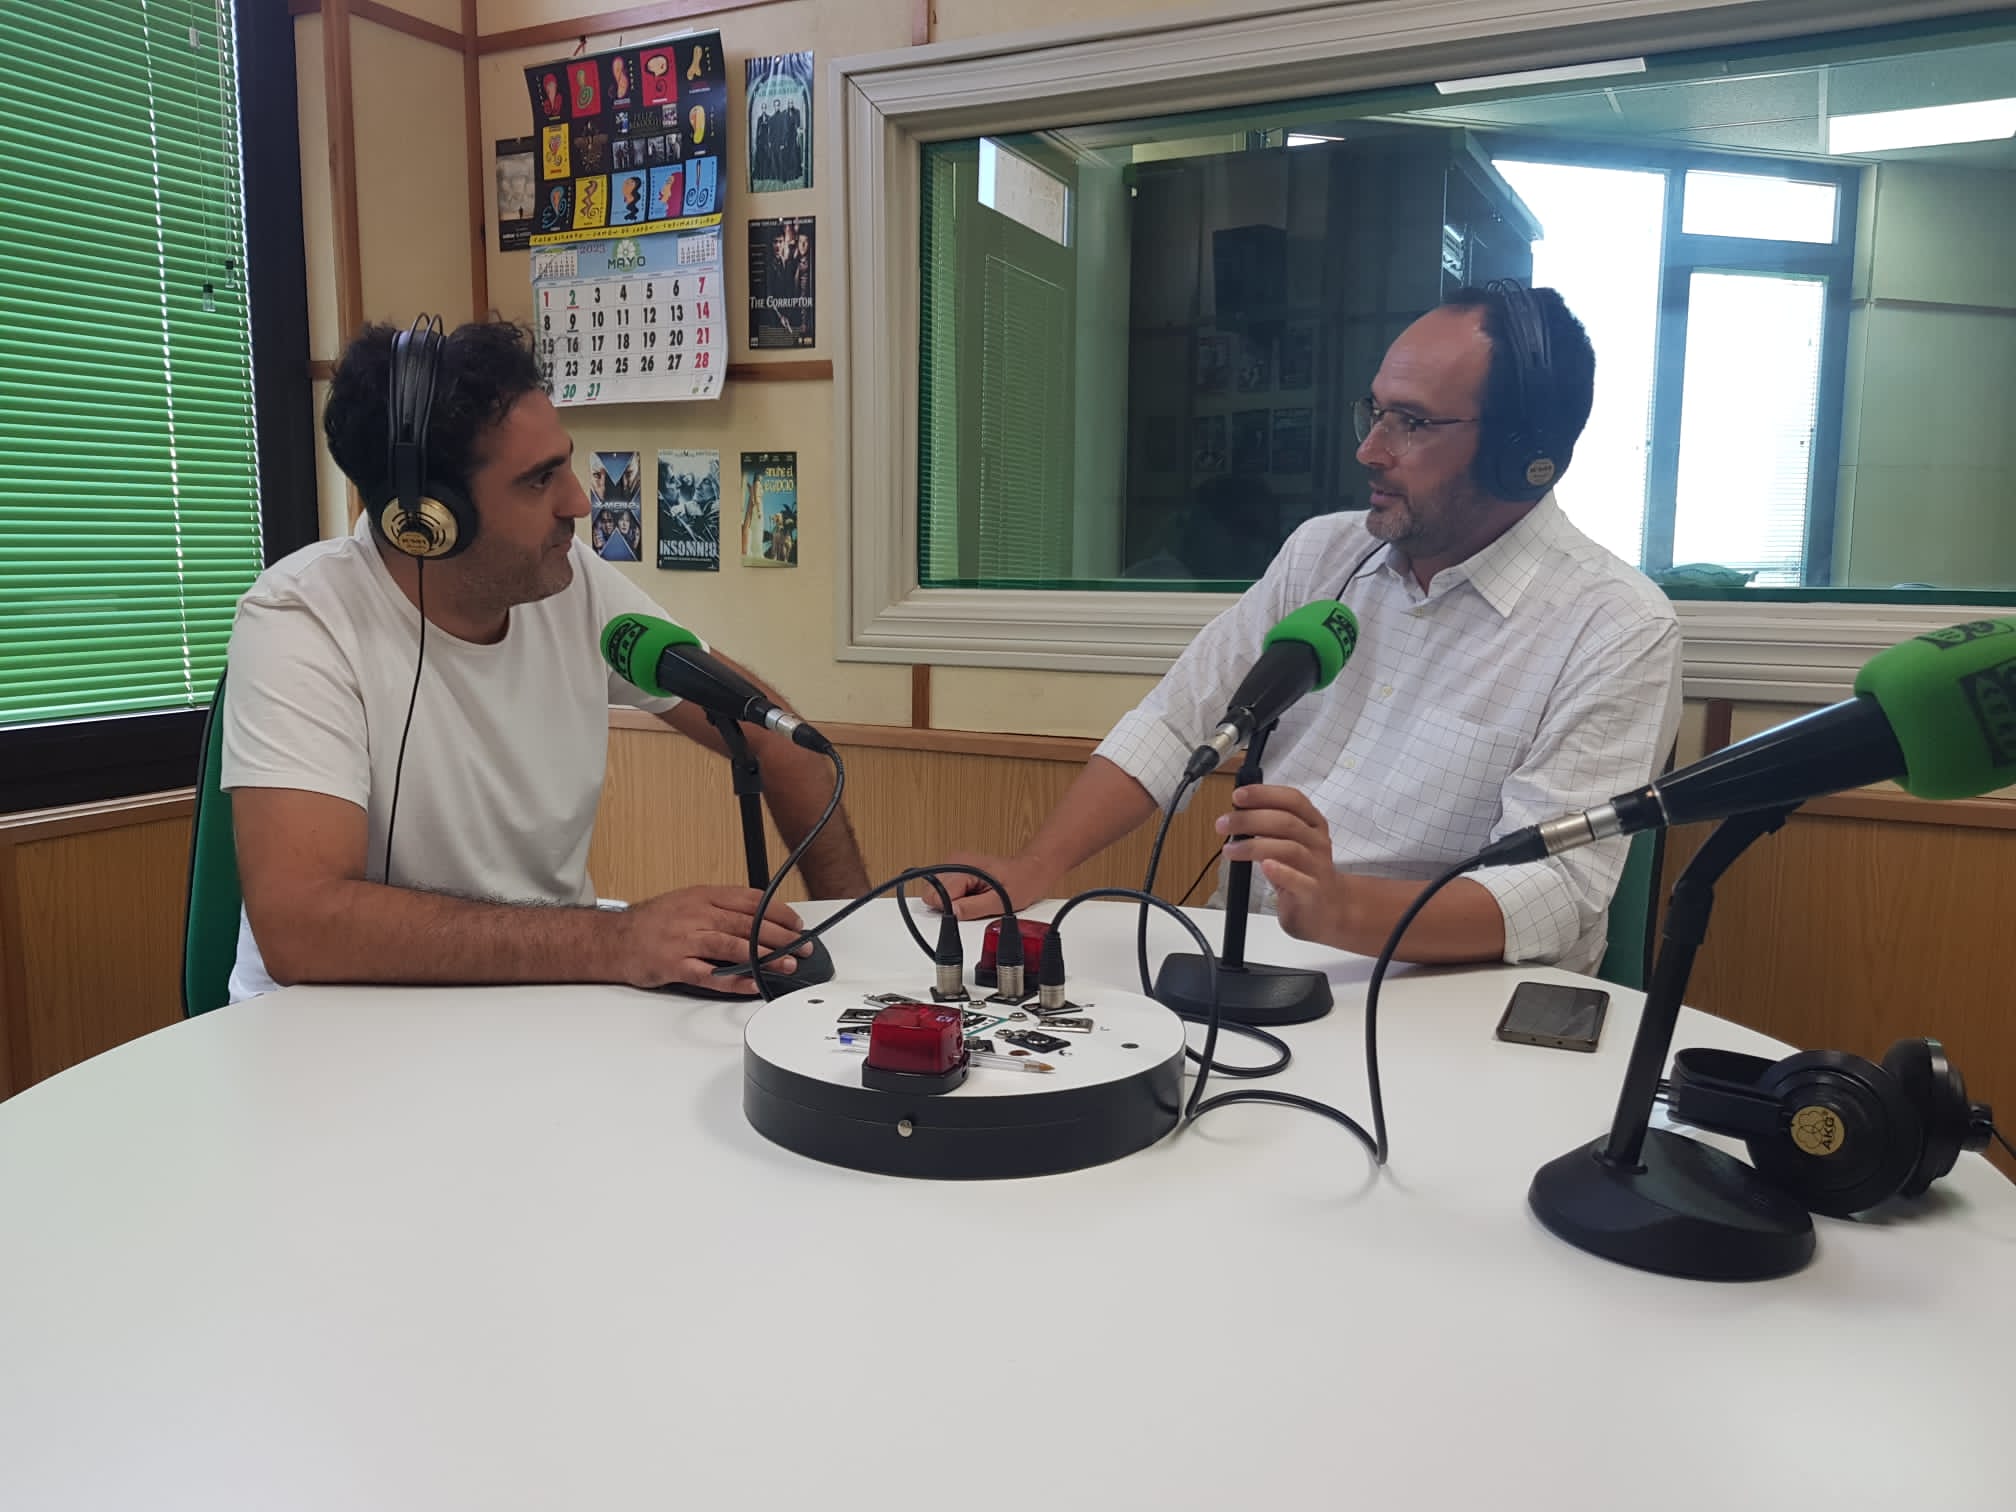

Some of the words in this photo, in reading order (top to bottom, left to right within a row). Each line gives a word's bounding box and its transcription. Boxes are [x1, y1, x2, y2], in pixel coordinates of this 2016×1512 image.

[607, 256, 646, 269] MAYO
[543, 290, 549, 307] 1
[569, 289, 576, 306] 2
[594, 287, 601, 303] 3
[620, 284, 627, 301] 4
[646, 282, 653, 299] 5
[673, 279, 680, 296] 6
[698, 276, 706, 293] 7
[750, 296, 765, 308] THE
[766, 295, 813, 308] CORRUPTOR
[543, 314, 551, 331] 8
[569, 313, 576, 330] 9
[591, 311, 604, 328] 10
[616, 308, 630, 325] 11
[643, 306, 656, 324] 12
[670, 304, 684, 321] 13
[696, 301, 710, 319] 14
[566, 338, 579, 353] 16
[591, 334, 604, 351] 17
[617, 333, 630, 350] 18
[643, 332, 656, 348] 19
[669, 329, 684, 346] 20
[696, 327, 710, 344] 21
[565, 360, 578, 376] 23
[590, 358, 603, 375] 24
[615, 357, 629, 373] 25
[640, 355, 654, 372] 26
[667, 353, 683, 370] 27
[694, 352, 710, 369] 28
[562, 384, 577, 399] 30
[587, 382, 601, 398] 31
[1822, 1117, 1835, 1151] AKG
